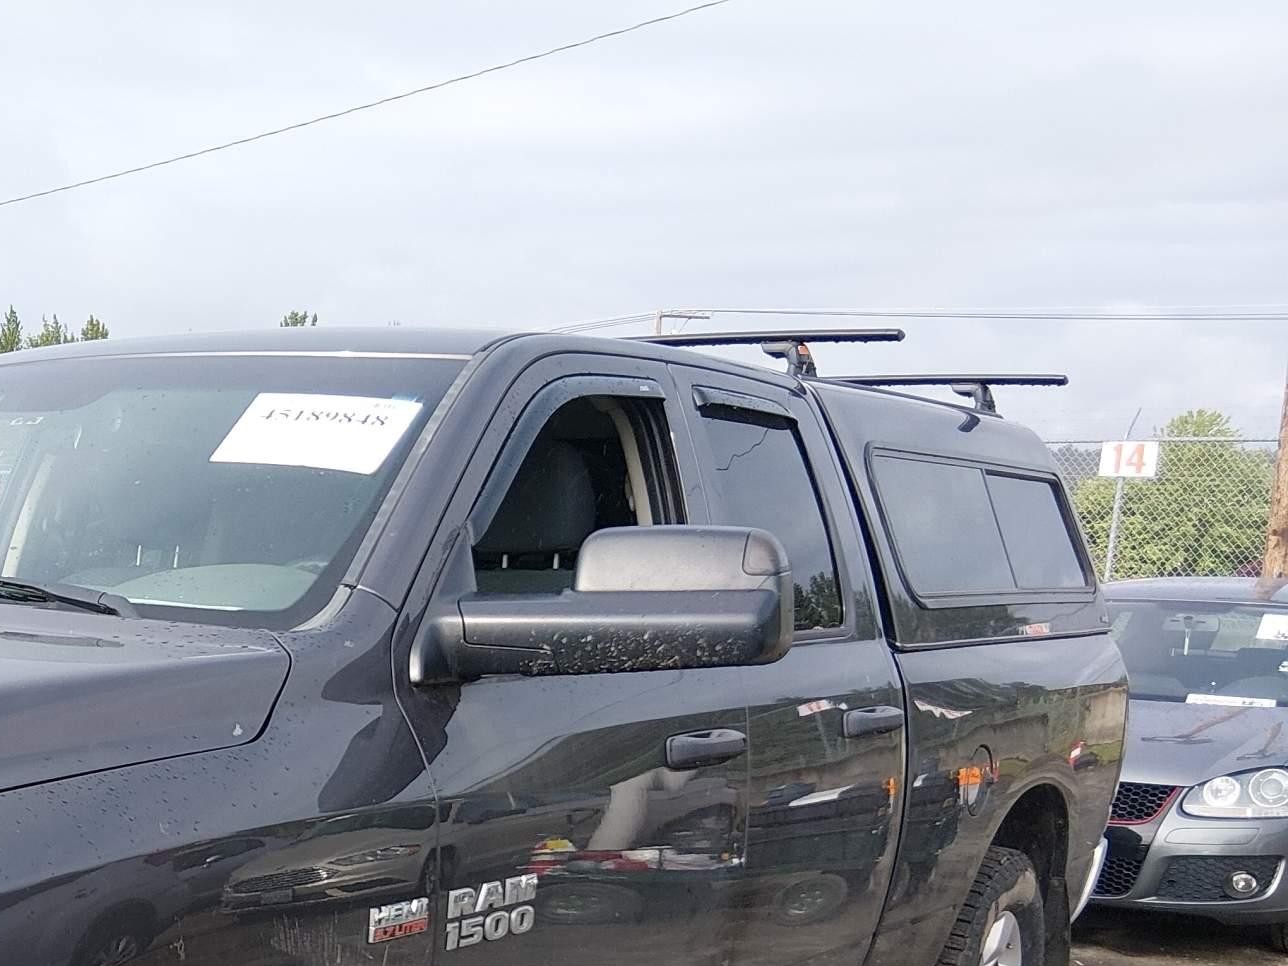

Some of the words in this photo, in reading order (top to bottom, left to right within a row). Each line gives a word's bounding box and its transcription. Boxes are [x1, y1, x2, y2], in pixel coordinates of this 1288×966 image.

[261, 408, 390, 427] 45189848
[1114, 443, 1146, 474] 14
[447, 873, 538, 919] RAM
[369, 897, 429, 927] HEMI
[445, 905, 535, 951] 1500
